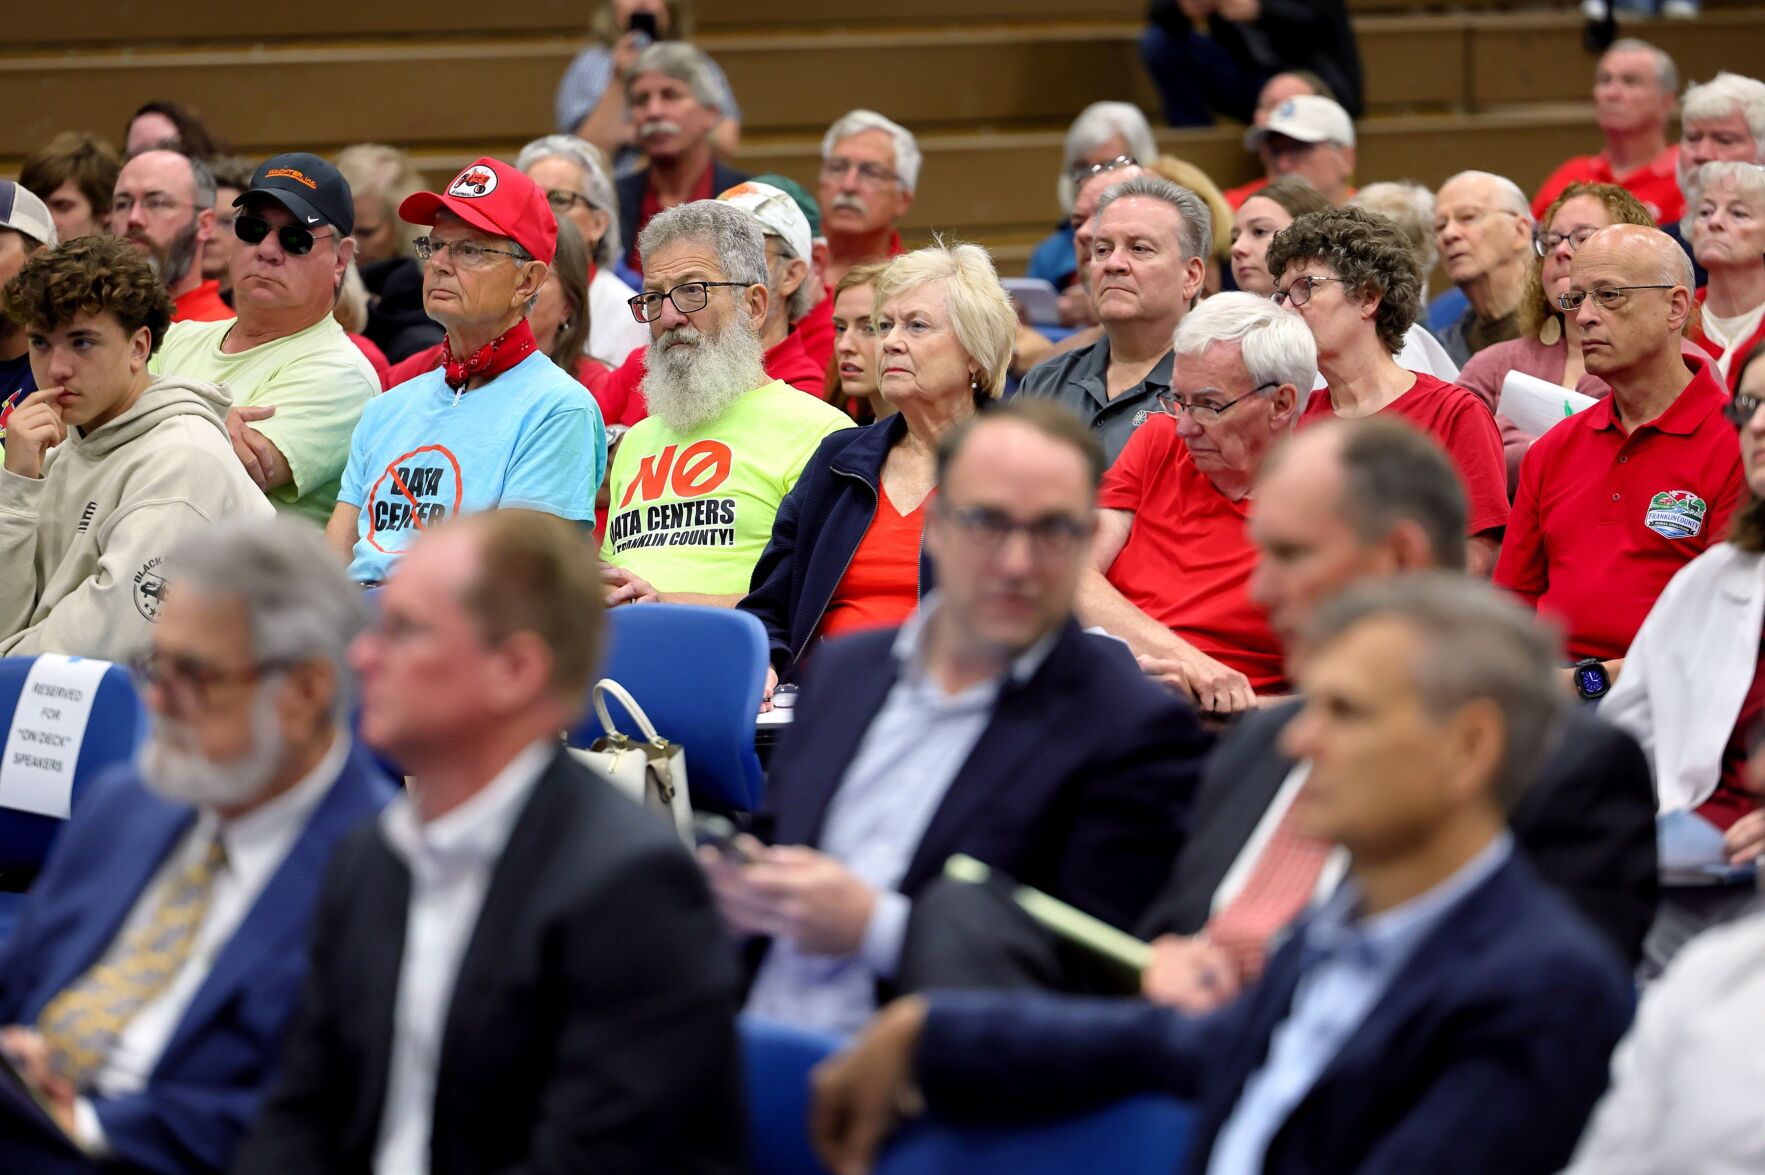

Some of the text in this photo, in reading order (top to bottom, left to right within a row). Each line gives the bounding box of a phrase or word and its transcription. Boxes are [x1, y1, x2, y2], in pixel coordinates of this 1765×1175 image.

[390, 467, 444, 497] DATA
[619, 439, 732, 509] NO
[647, 499, 736, 531] CENTERS
[1648, 512, 1700, 529] FRANKLIN COUNTY
[669, 528, 735, 545] COUNTY!
[133, 556, 163, 584] BLACK
[32, 682, 84, 702] RESERVED
[41, 706, 62, 721] FOR
[12, 752, 64, 773] SPEAKERS
